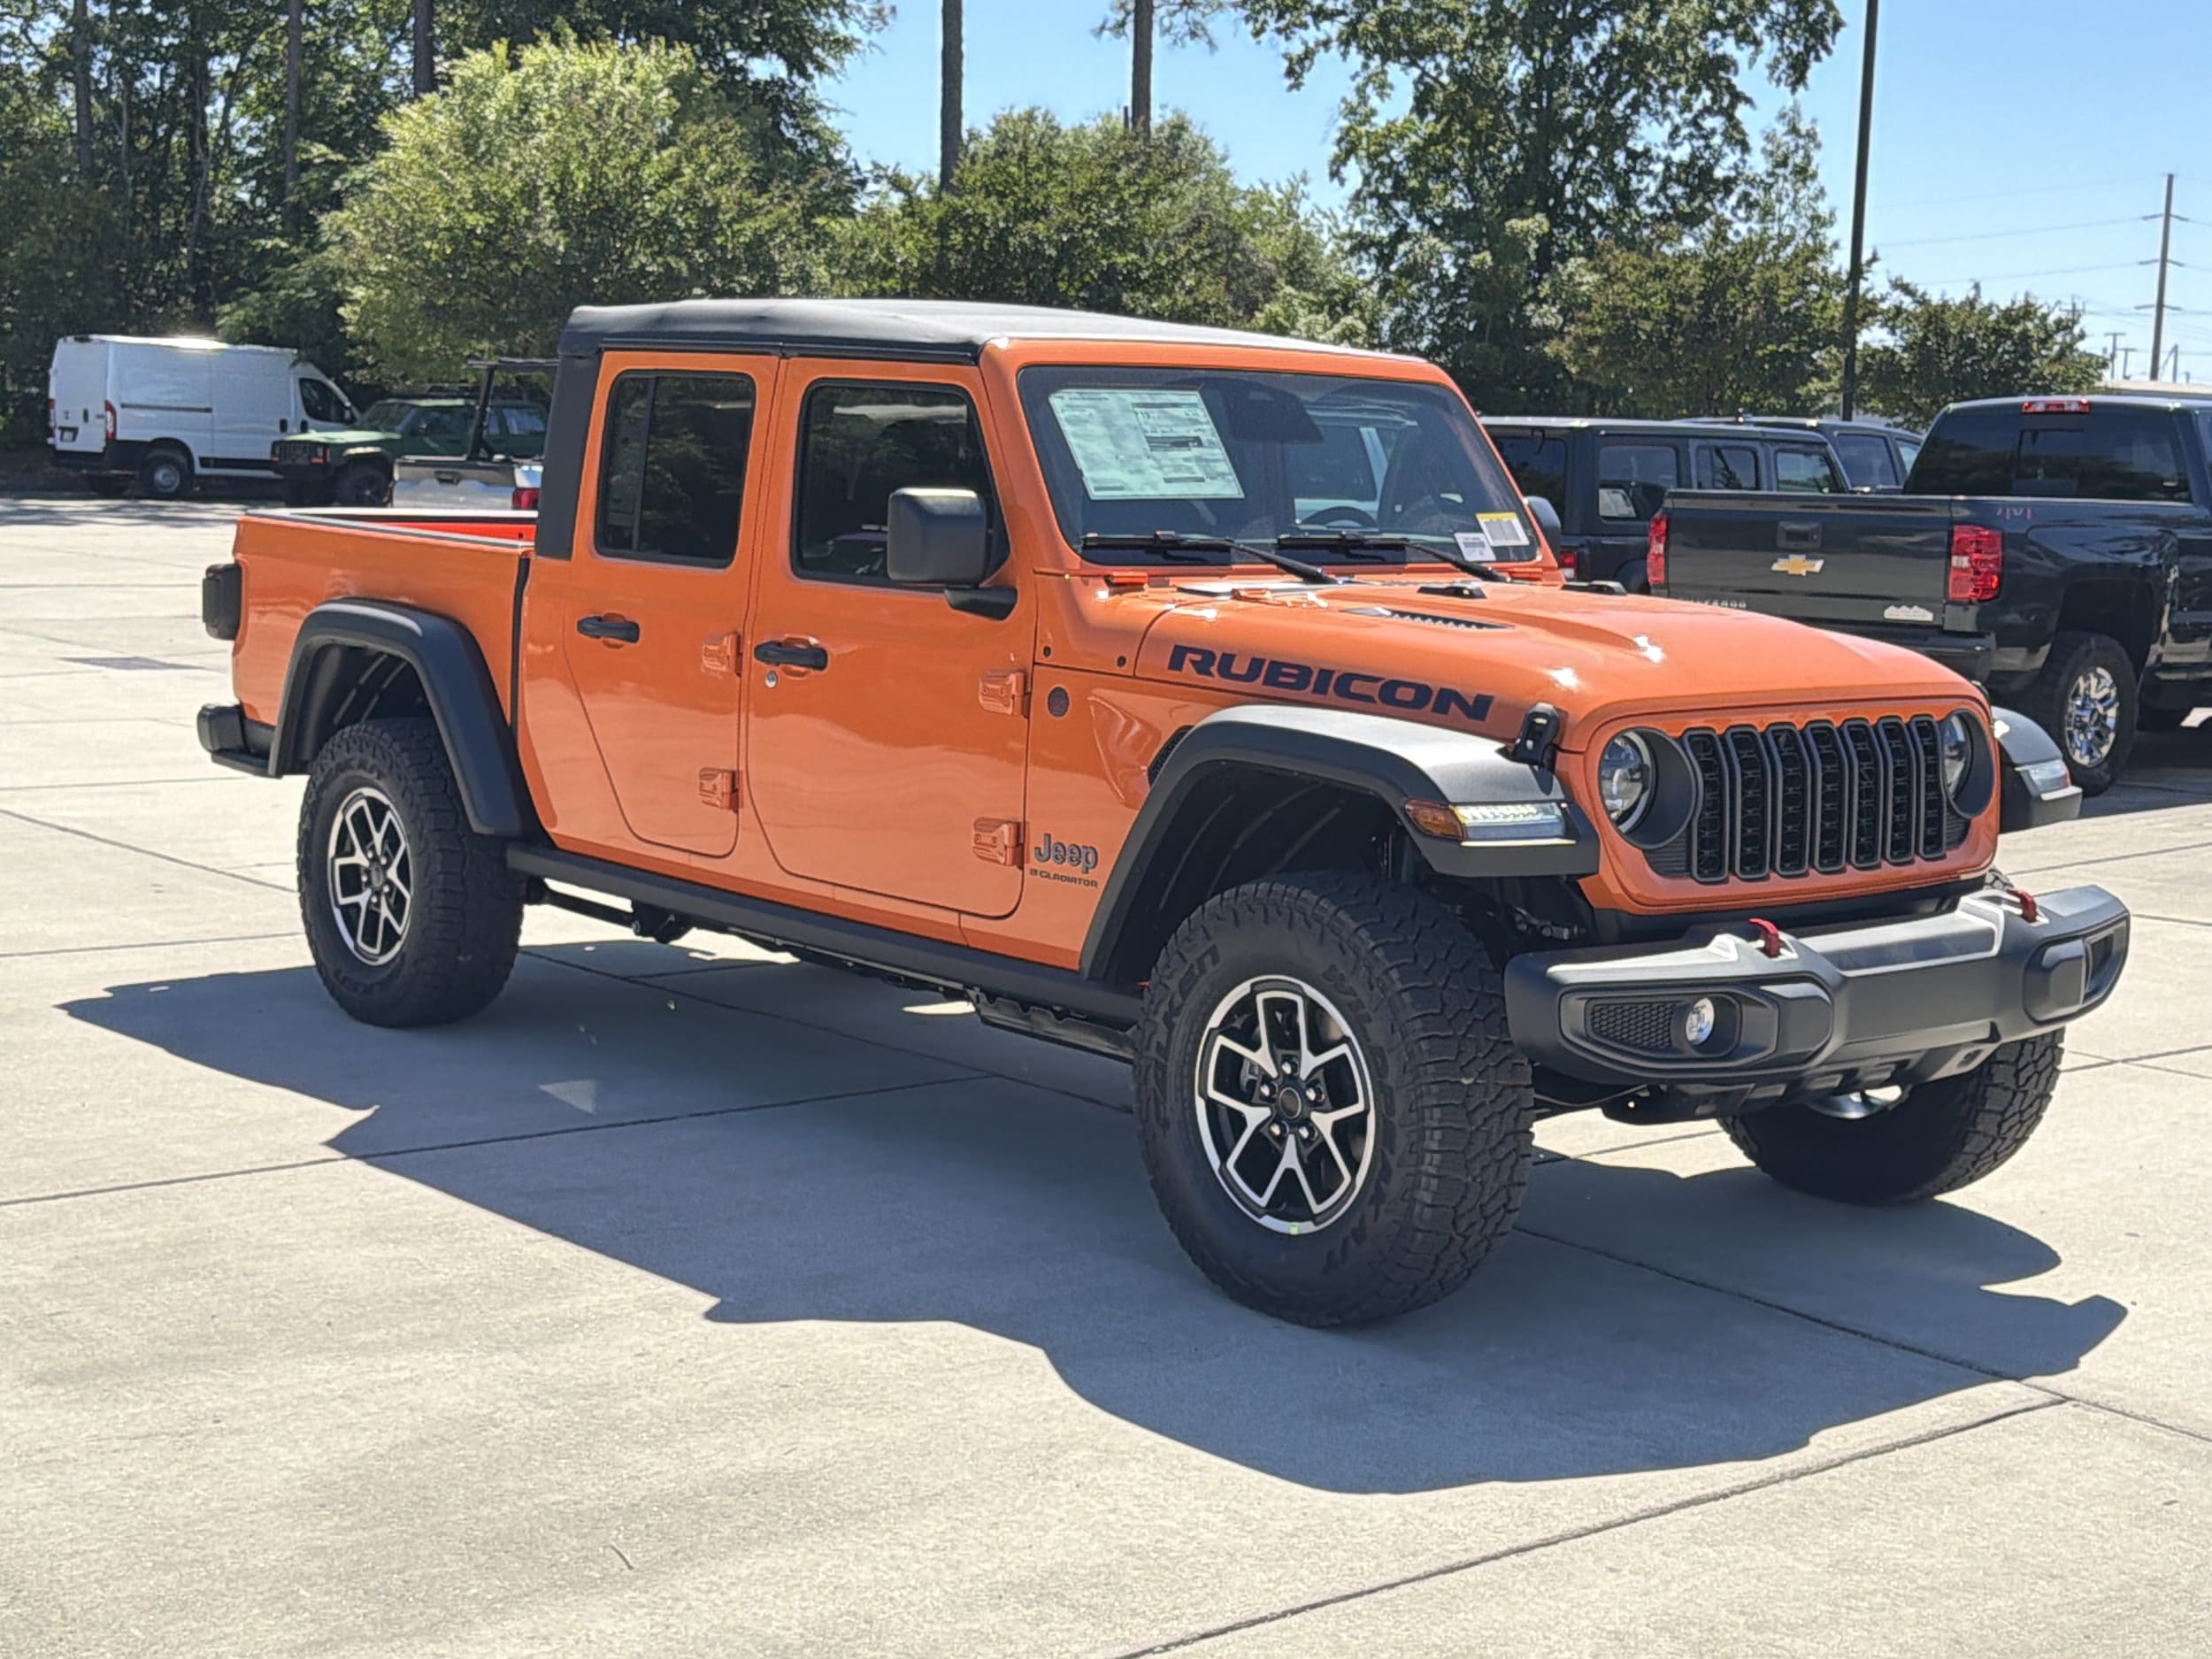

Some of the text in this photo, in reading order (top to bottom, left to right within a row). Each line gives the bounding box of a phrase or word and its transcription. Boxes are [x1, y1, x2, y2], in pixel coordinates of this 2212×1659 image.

[1168, 644, 1495, 722] RUBICON
[1033, 833, 1098, 874] Jeep
[1039, 870, 1098, 888] GLADIATOR
